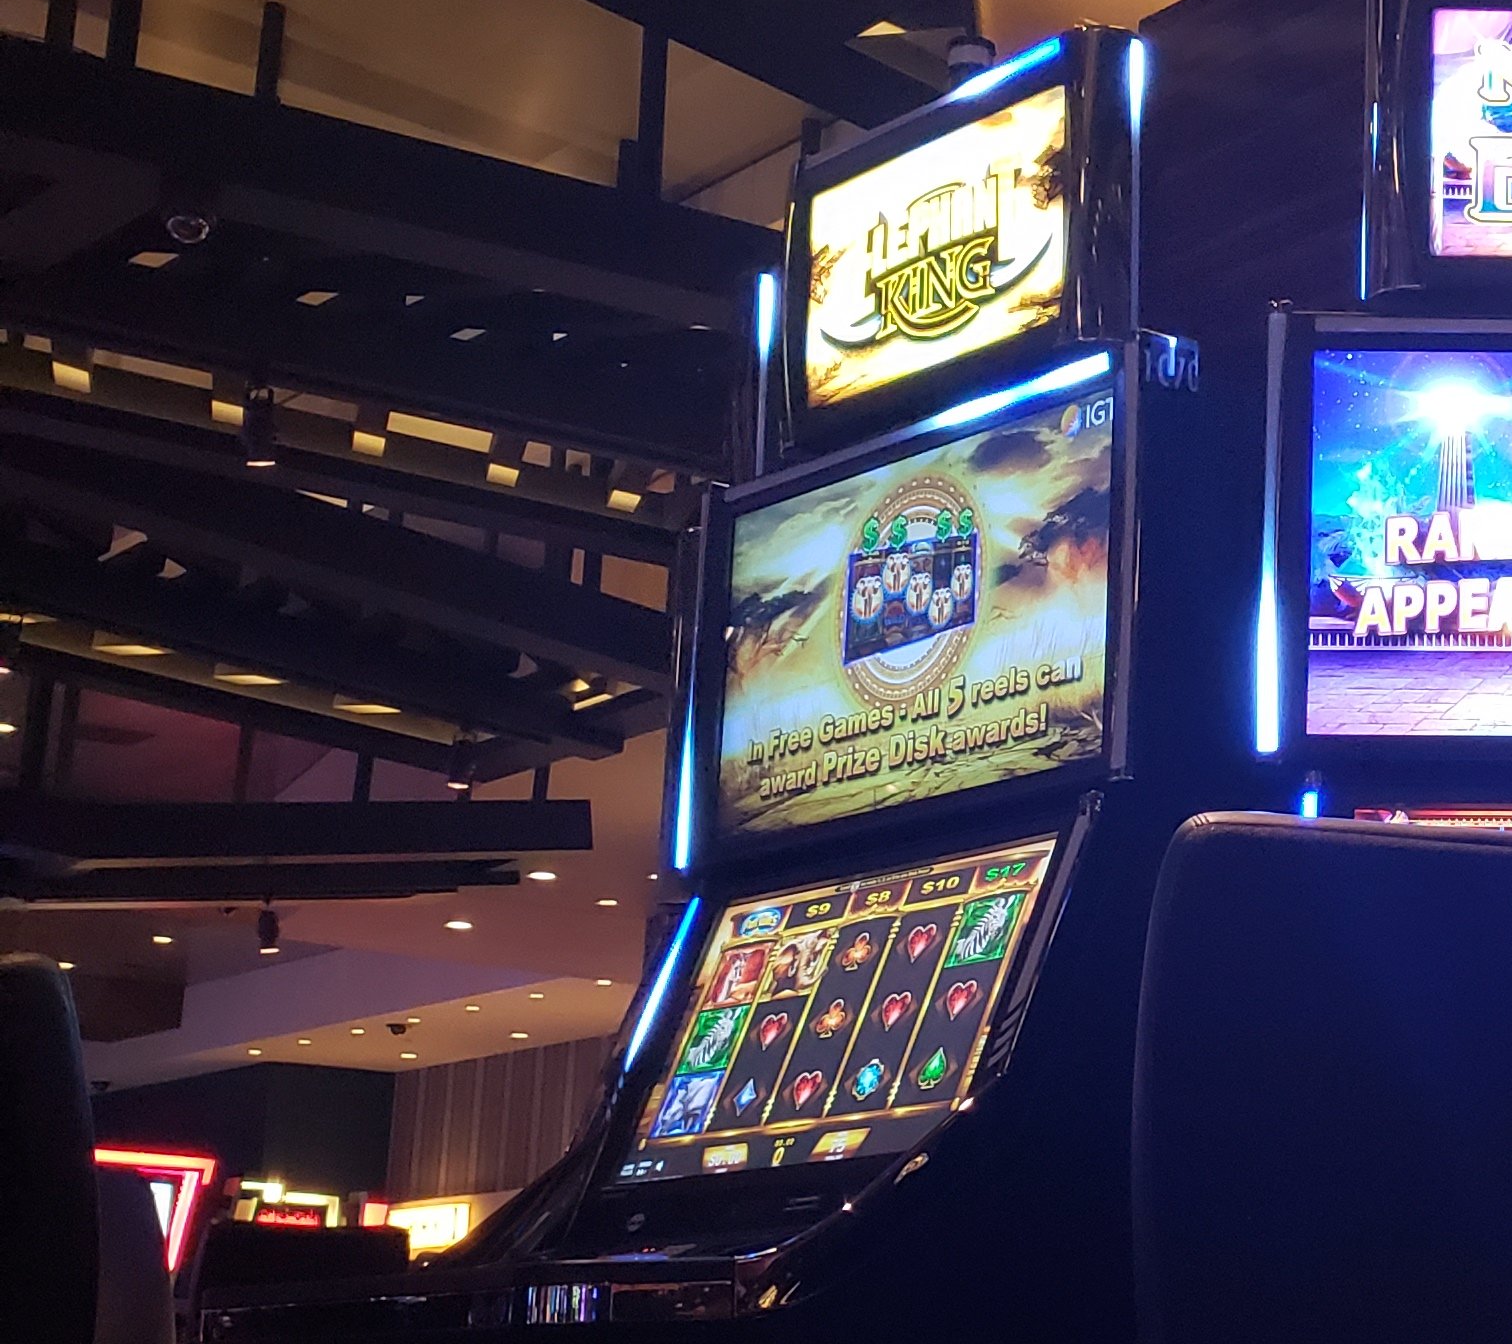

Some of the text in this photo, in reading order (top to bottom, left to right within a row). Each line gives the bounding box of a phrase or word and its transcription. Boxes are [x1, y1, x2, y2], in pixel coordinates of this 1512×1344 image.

[875, 236, 996, 340] KING
[746, 739, 765, 766] In
[768, 726, 812, 758] Free
[818, 702, 895, 744] Games
[911, 689, 940, 720] All
[947, 674, 967, 719] 5
[970, 667, 1030, 705] reels
[1036, 656, 1084, 688] can
[759, 703, 1049, 799] award Prize Disk awards!
[805, 902, 832, 919] $9
[865, 890, 892, 906] $8
[920, 876, 961, 896] $10
[985, 862, 1026, 883] $17
